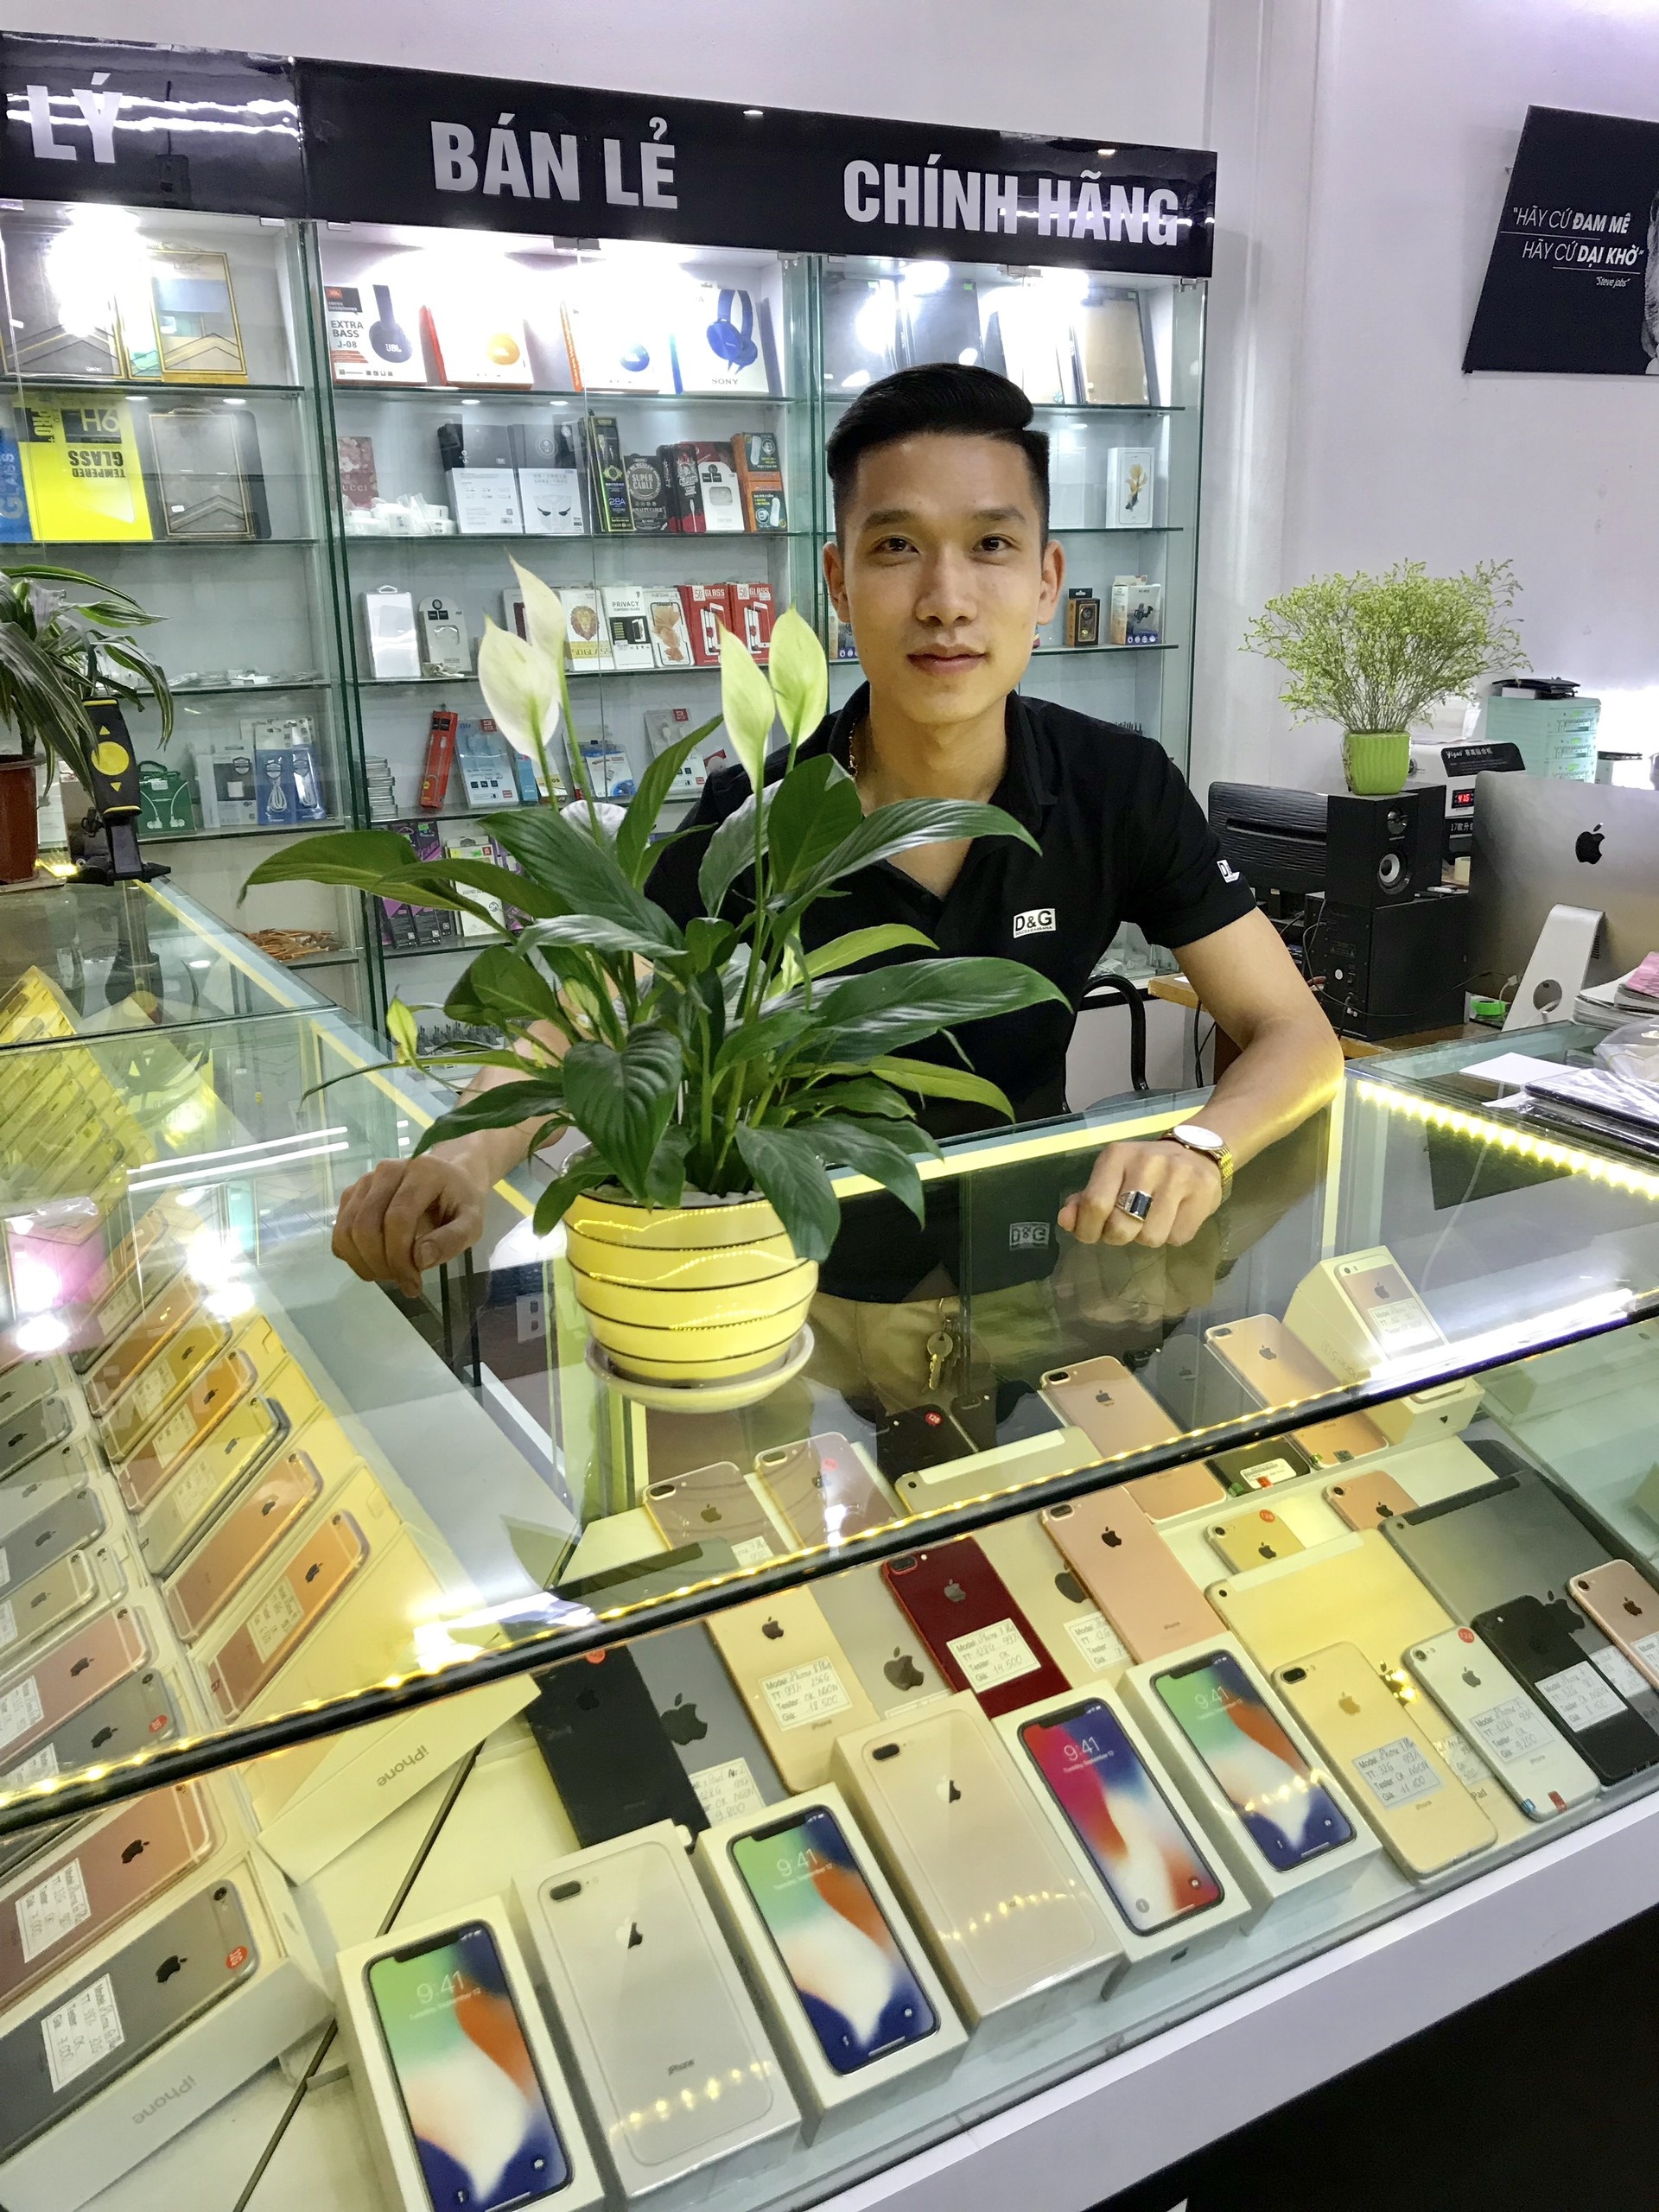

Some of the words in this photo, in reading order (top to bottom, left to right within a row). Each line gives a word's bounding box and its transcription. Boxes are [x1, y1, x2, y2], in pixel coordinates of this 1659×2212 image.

[26, 73, 123, 164] LÝ
[431, 113, 582, 201] BÁN
[604, 117, 679, 208] LẺ
[843, 153, 1019, 234] CHÍNH
[1037, 170, 1178, 245] HÃNG
[1548, 208, 1573, 229] CỨ
[1572, 213, 1607, 232] ĐAM
[1608, 213, 1631, 234] MÊ
[1522, 238, 1555, 260] HÃY
[1554, 240, 1580, 262] CỨ
[1577, 245, 1604, 268] DẠI
[331, 320, 364, 329] EXTRA
[332, 329, 359, 338] BASS
[385, 343, 403, 353] JBL
[68, 450, 124, 467] GLASS
[72, 468, 125, 479] TEMPERED
[704, 588, 725, 597] GLASS
[1015, 910, 1052, 931] D&G
[1260, 1511, 1273, 1520] 128
[1193, 1684, 1229, 1711] 9:41
[1063, 1735, 1100, 1762] 9:41
[377, 1745, 429, 1787] iPhone
[1469, 1786, 1487, 1801] Pad
[775, 1847, 818, 1878] 9:41
[229, 1948, 244, 1967] 32G
[413, 1969, 467, 2005] 9:41
[666, 2057, 696, 2075] iPhone
[132, 2075, 197, 2126] iPhone
